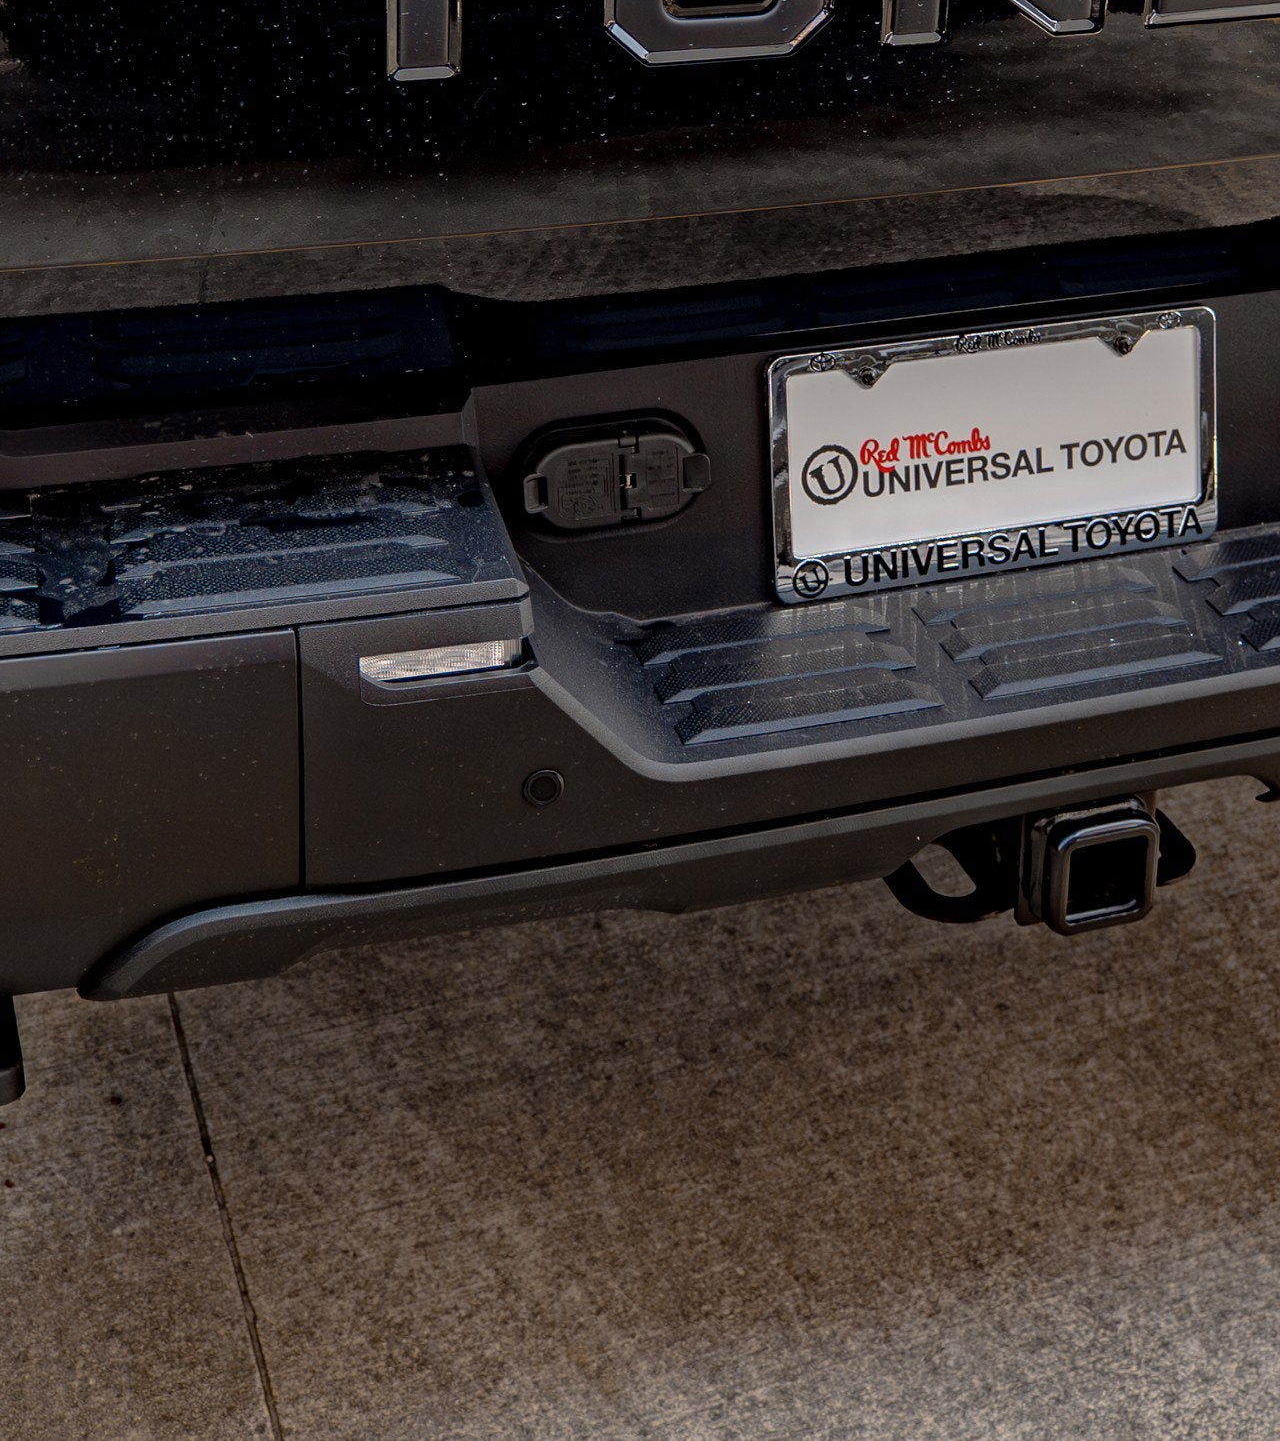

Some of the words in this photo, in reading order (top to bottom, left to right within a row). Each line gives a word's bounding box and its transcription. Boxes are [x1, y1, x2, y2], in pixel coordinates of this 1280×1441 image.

[859, 438, 900, 473] Red
[902, 427, 991, 460] McCombs
[862, 447, 1055, 498] UNIVERSAL
[1059, 429, 1187, 470] TOYOTA
[844, 527, 1060, 587] UNIVERSAL
[1063, 505, 1203, 553] TOYOTA
